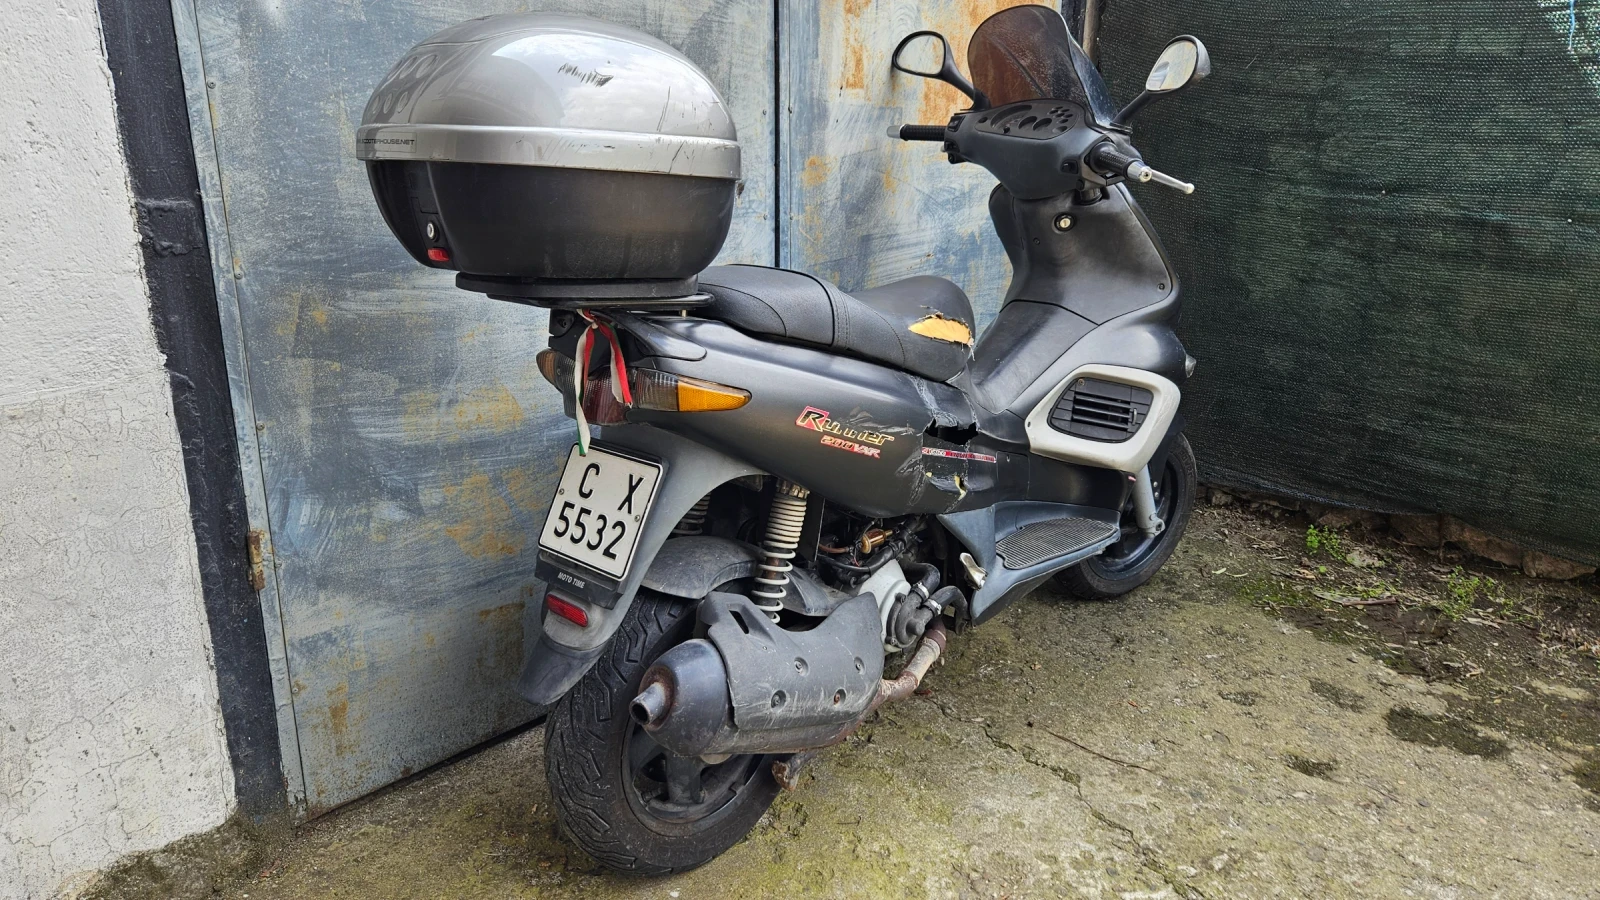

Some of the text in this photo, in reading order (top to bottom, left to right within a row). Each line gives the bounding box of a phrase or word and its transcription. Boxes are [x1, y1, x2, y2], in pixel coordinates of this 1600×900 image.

[797, 407, 895, 446] Runner
[578, 462, 644, 515] C X
[553, 500, 626, 561] 5532
[557, 571, 586, 589] MOTO TIME
